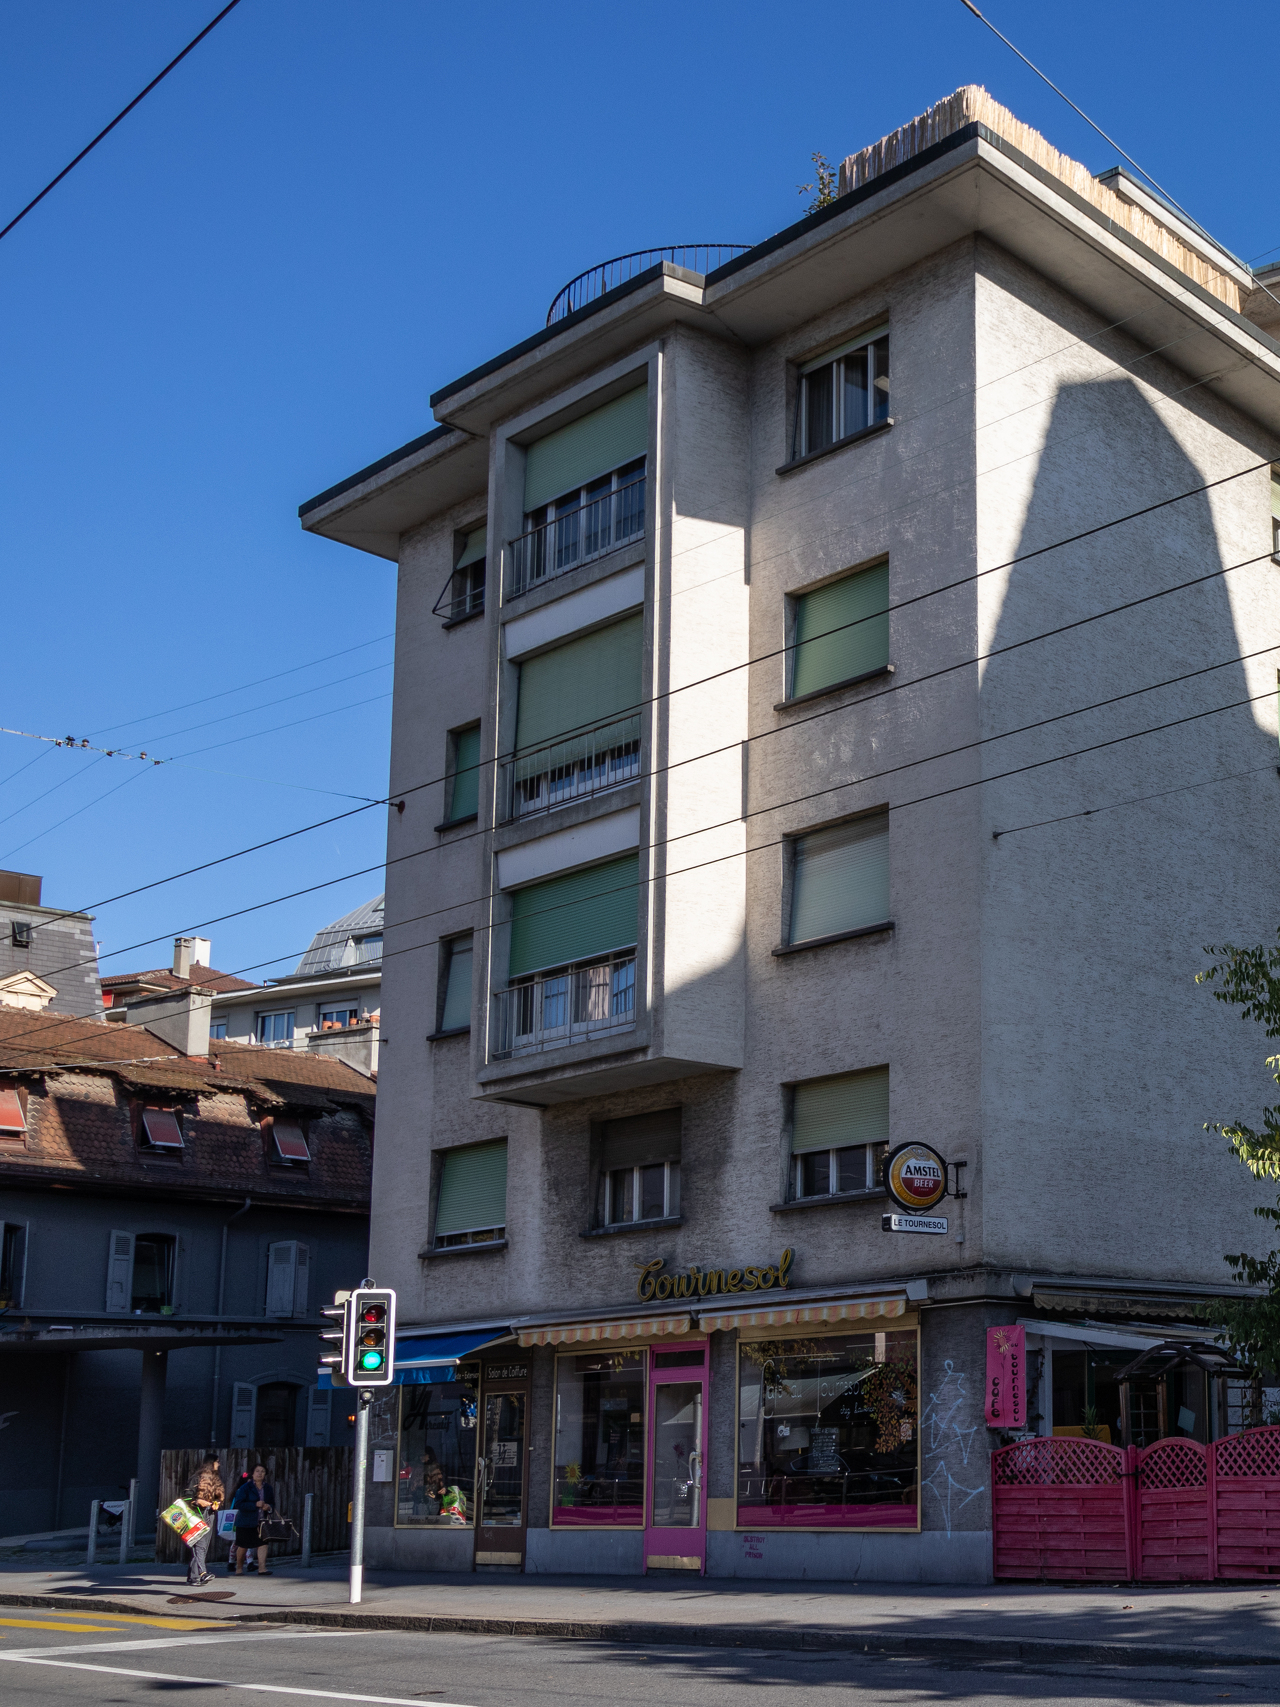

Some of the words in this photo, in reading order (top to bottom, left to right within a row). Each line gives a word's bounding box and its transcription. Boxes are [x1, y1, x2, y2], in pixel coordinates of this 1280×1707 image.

[904, 1164, 941, 1178] AMSTEL
[914, 1179, 934, 1188] BEER
[894, 1219, 903, 1227] LE
[904, 1219, 946, 1230] TOURNESOL
[634, 1247, 794, 1301] Tournesol
[488, 1367, 500, 1379] Salon
[501, 1367, 507, 1378] de
[508, 1365, 527, 1378] Coiffure
